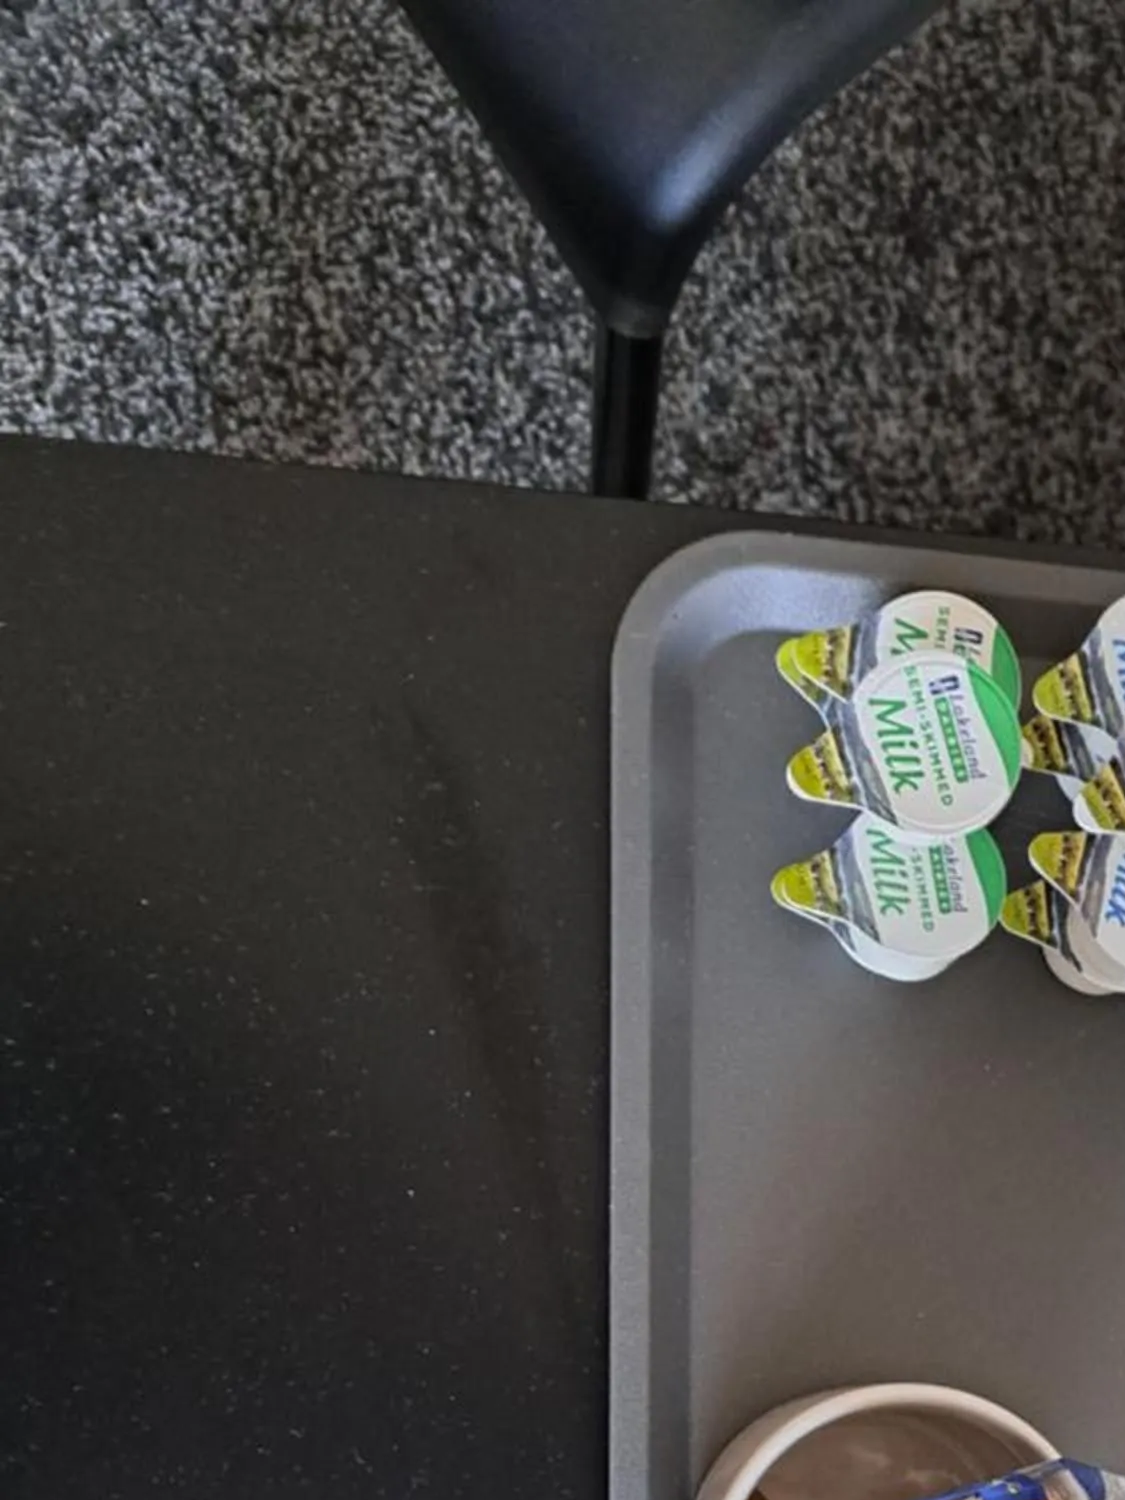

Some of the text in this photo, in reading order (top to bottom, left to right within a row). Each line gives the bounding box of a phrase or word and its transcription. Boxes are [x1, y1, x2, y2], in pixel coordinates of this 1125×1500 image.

[868, 697, 925, 794] Milk
[904, 665, 953, 806] SEMI-SKIMMED
[950, 694, 988, 780] Lakeland
[866, 828, 911, 916] Milk
[944, 841, 969, 913] akeland
